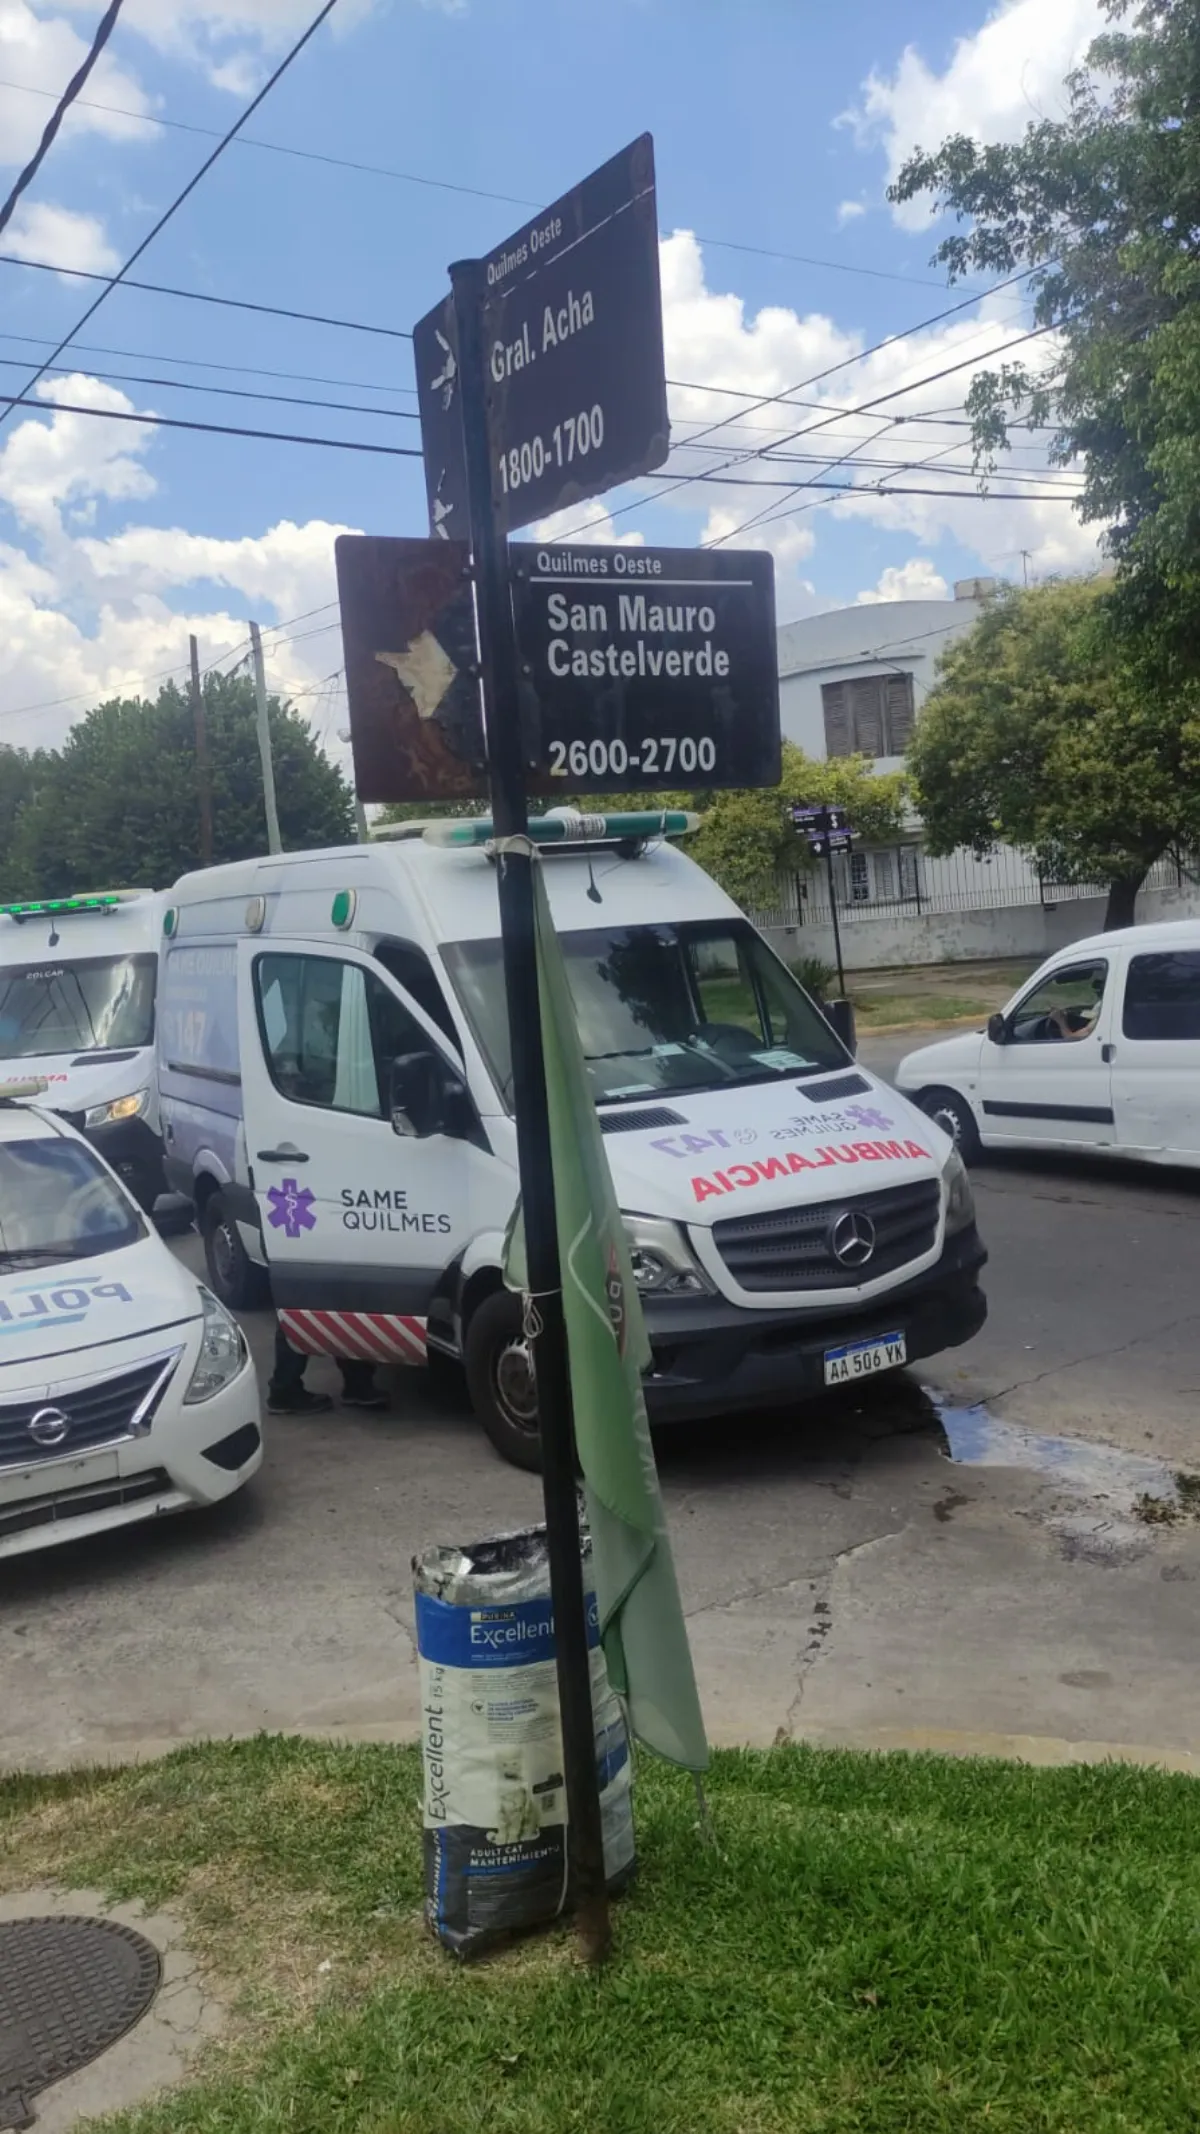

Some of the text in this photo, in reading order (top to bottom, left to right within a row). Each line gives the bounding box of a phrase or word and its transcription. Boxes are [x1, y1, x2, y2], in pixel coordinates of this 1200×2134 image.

[487, 216, 562, 285] Quilmes Oeste
[490, 290, 594, 382] Gral. Acha
[499, 404, 604, 493] 1800-1700
[537, 551, 662, 574] Quilmes Oeste
[548, 593, 716, 632] San Mauro
[548, 638, 730, 677] Castelverde
[549, 736, 716, 776] 2600-2700
[341, 1188, 408, 1210] SAME
[342, 1210, 451, 1234] QUILMES
[831, 1360, 849, 1380] AA
[853, 1349, 881, 1373] 506
[886, 1342, 904, 1363] YK
[424, 1666, 451, 1821] Excellent 15 kg
[470, 1844, 523, 1857] ADULT CAT
